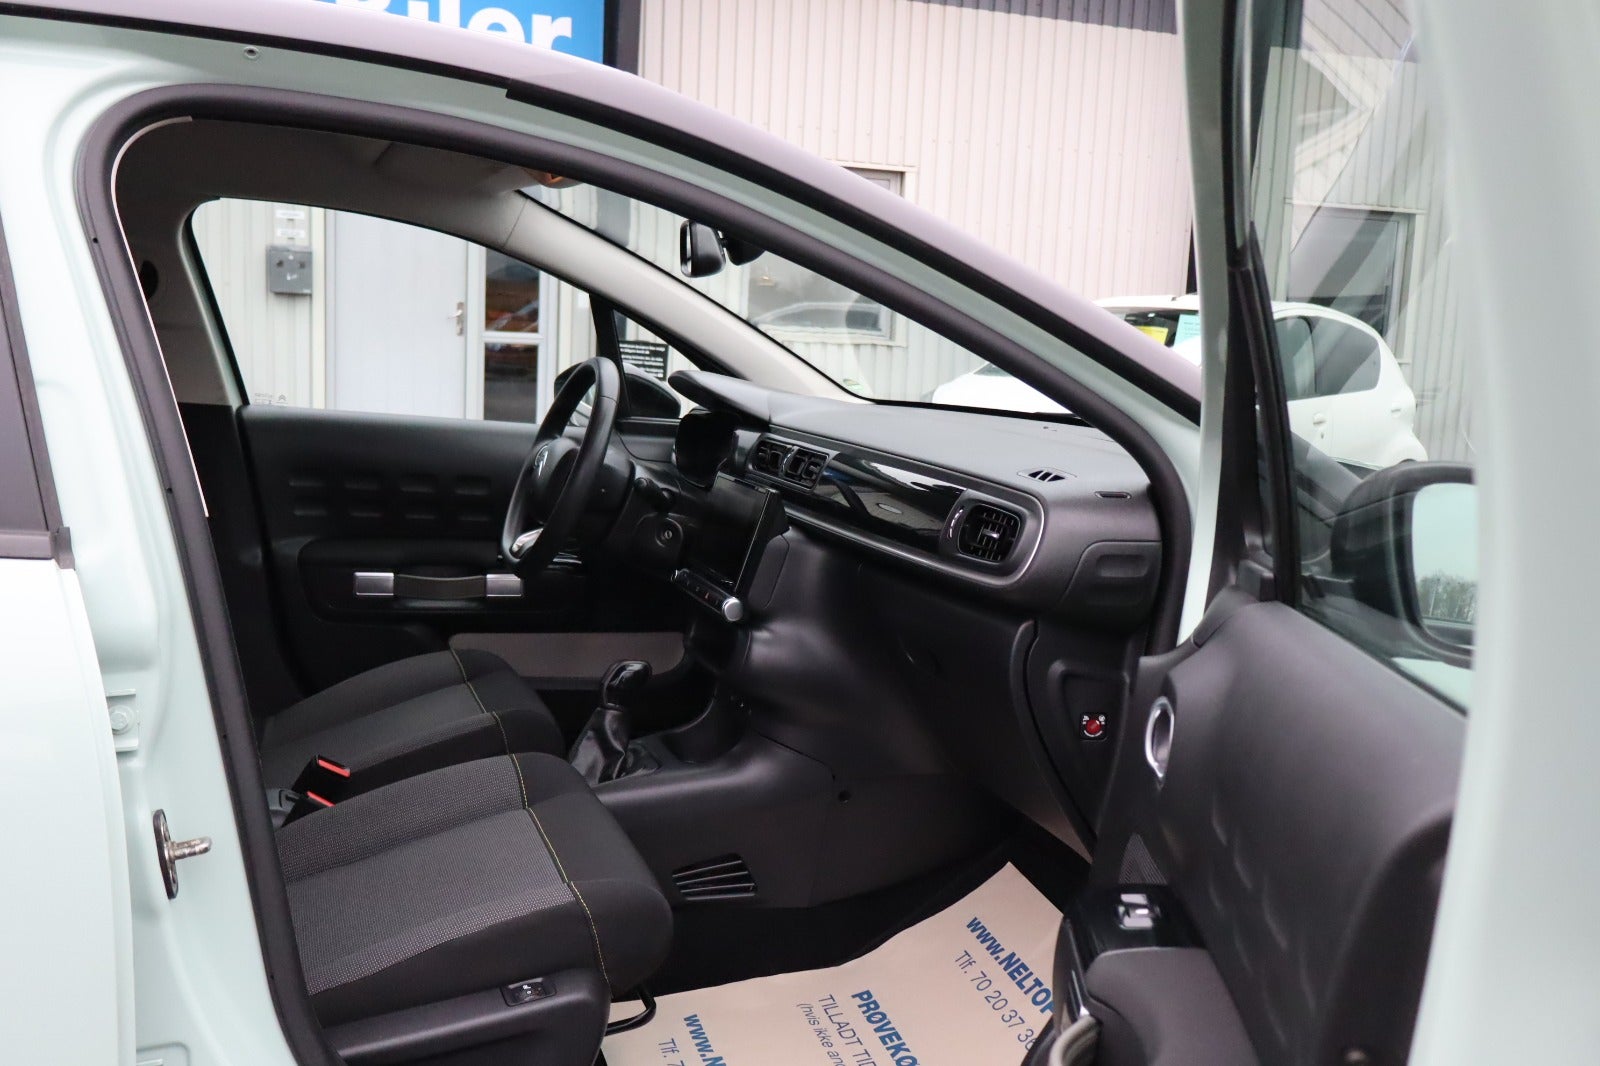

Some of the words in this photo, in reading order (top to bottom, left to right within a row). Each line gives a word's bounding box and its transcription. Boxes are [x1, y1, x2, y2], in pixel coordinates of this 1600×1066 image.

[955, 950, 976, 974] Tlf.
[970, 970, 992, 992] 70
[984, 990, 1008, 1011] 20
[1001, 1009, 1025, 1028] 37
[796, 1003, 820, 1026] (hvis
[813, 1028, 834, 1048] ikke
[818, 994, 863, 1046] TILLADT
[658, 1037, 680, 1058] Tlf.
